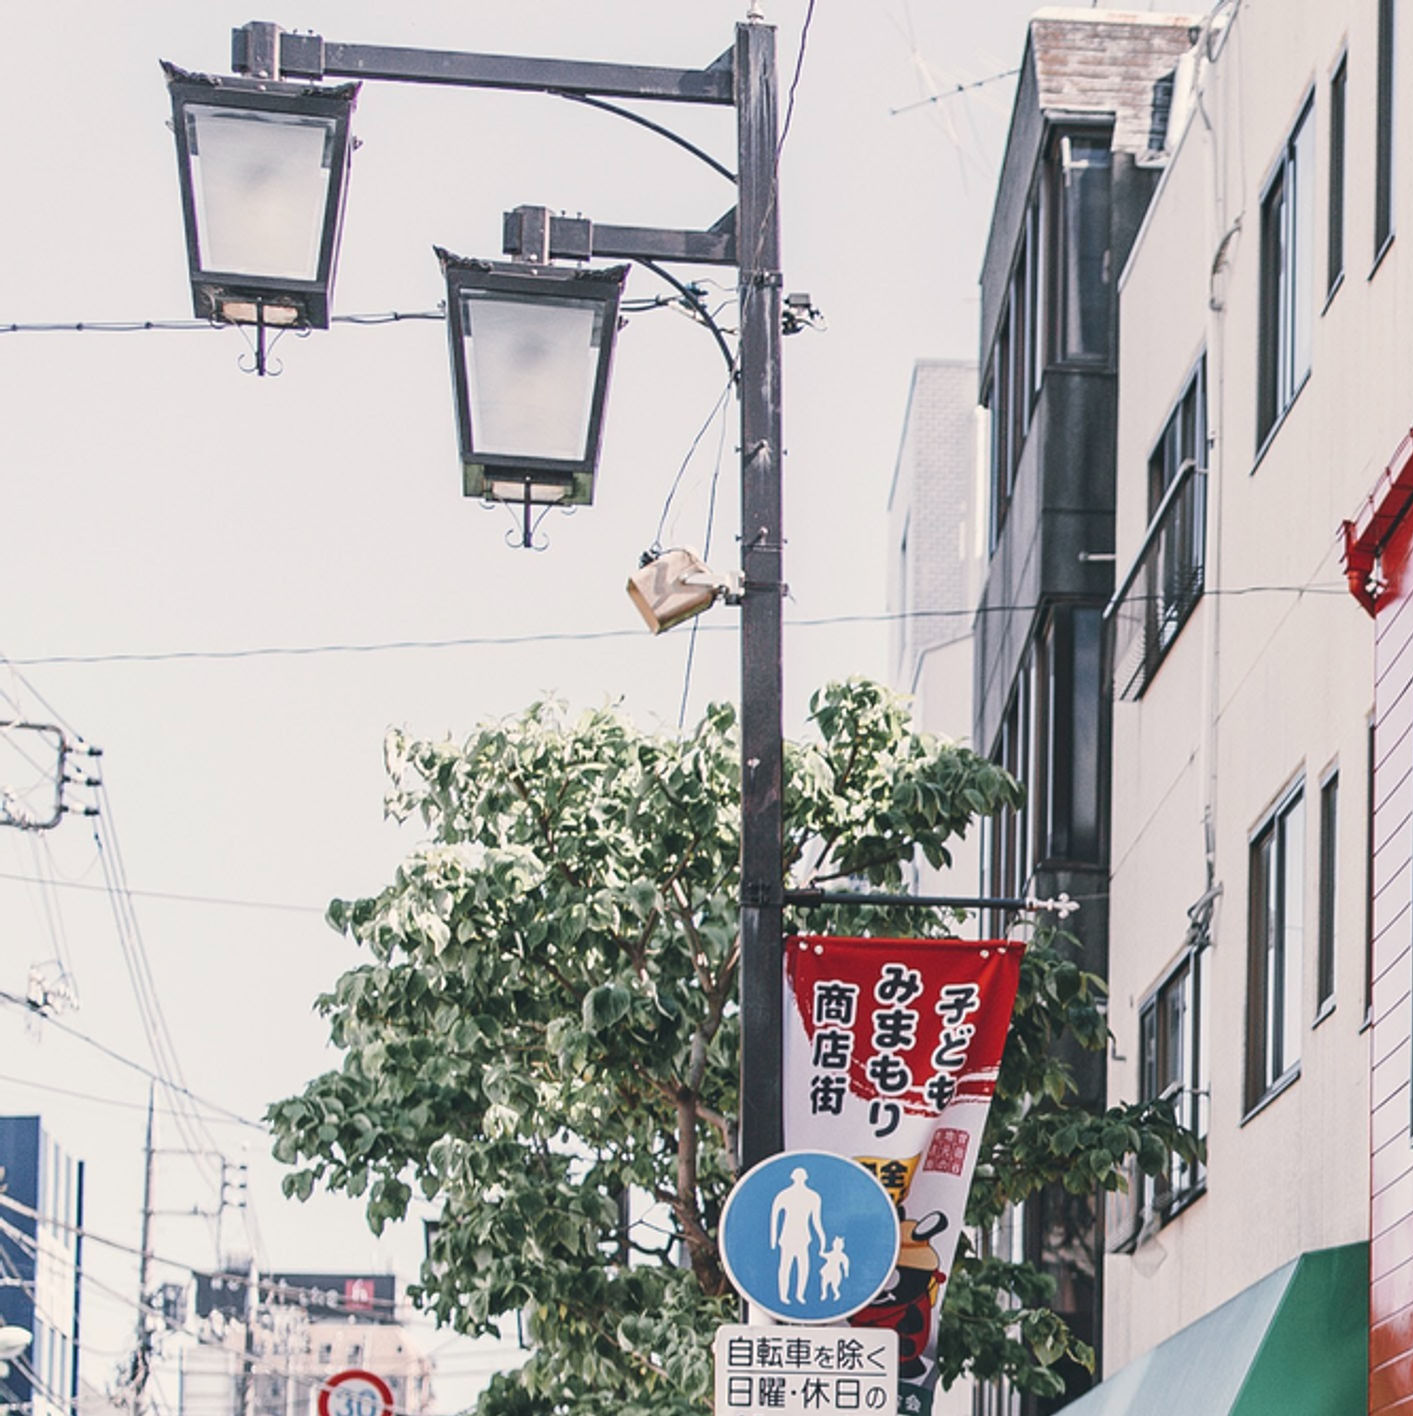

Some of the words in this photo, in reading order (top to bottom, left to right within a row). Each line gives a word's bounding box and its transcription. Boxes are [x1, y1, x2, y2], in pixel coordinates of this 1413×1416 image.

[810, 983, 857, 1116] 商店街
[868, 966, 920, 1138] みまもり
[927, 986, 977, 1111] 子ども
[728, 1336, 886, 1370] 自転車を除く
[728, 1377, 887, 1409] 日曜・休日の
